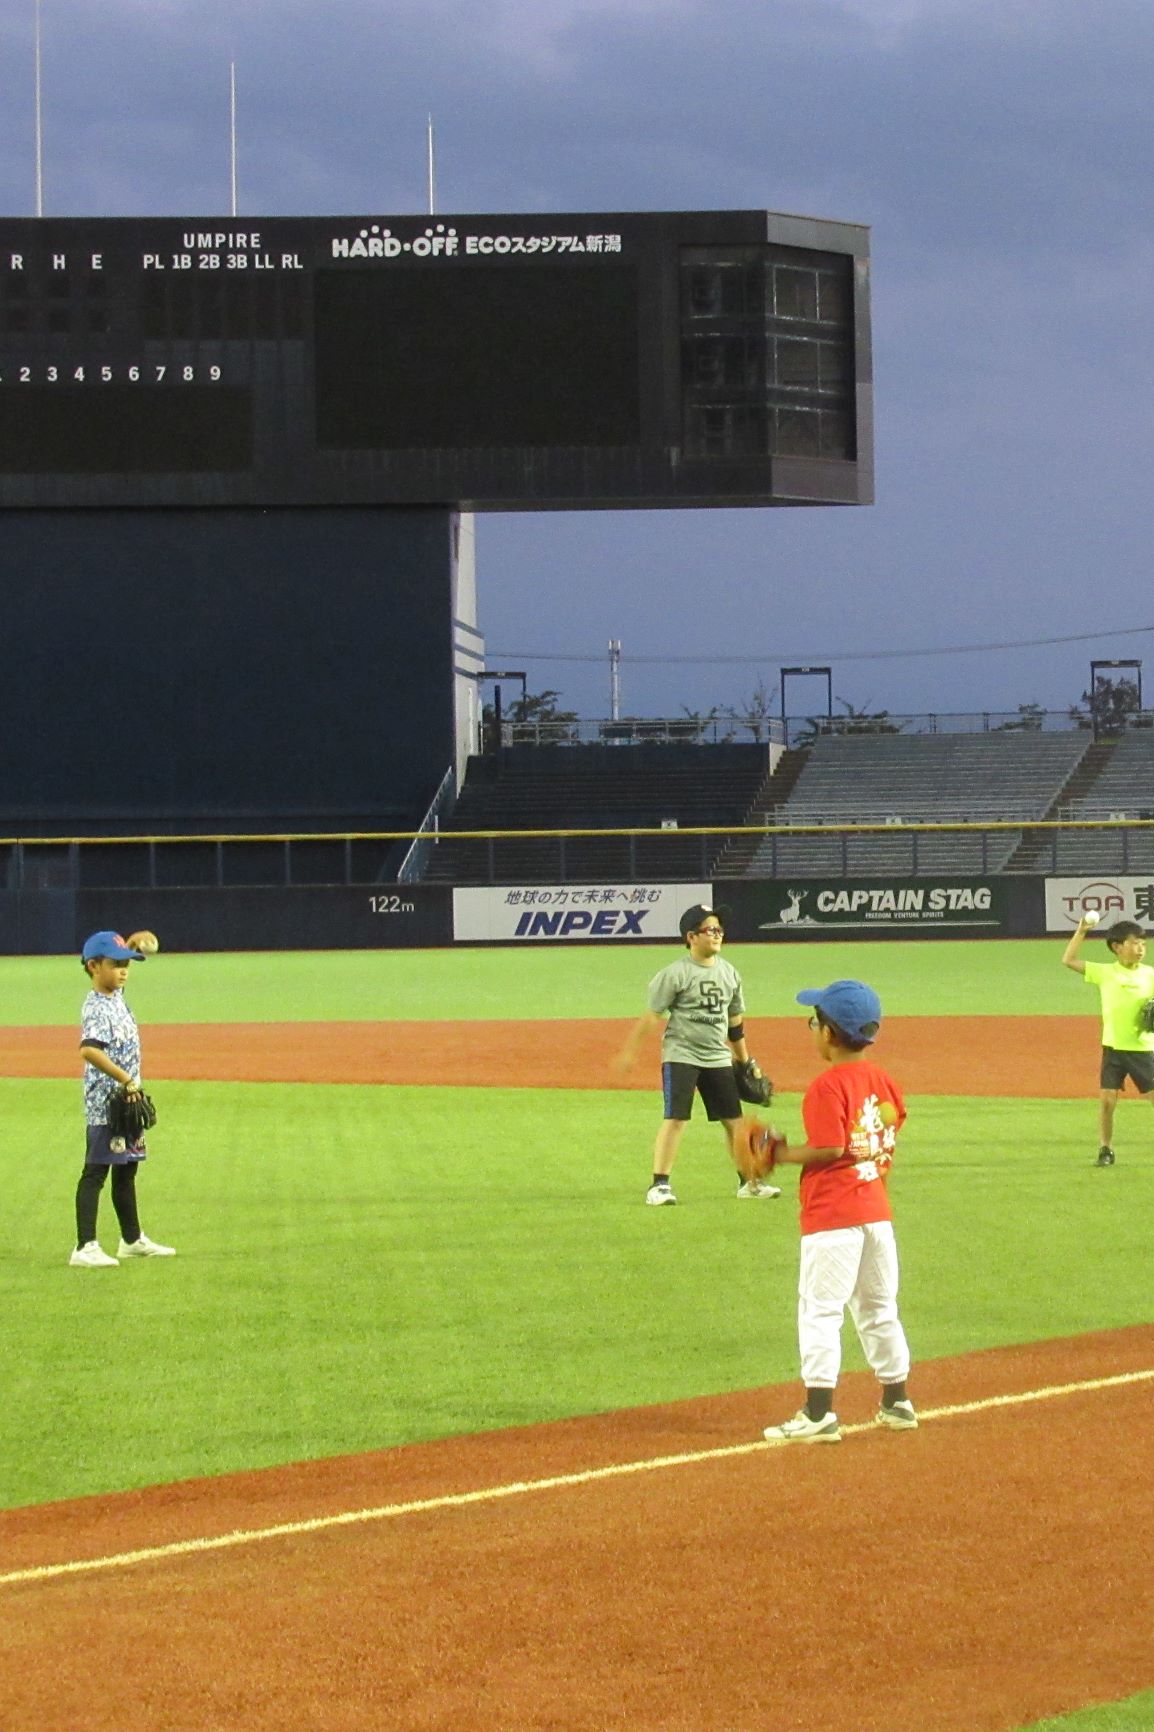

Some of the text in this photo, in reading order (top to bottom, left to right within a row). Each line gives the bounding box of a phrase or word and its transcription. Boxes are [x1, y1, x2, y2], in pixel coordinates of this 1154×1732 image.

[183, 233, 261, 249] UMPIRE
[11, 254, 23, 270] R
[53, 254, 66, 270] H
[92, 254, 102, 270] E
[143, 254, 304, 269] PL 1B 2B 3B LL RL
[20, 366, 221, 382] 2 3 4 5 6 7 8 9
[504, 888, 662, 906] 地球の力で未来へ挑む
[817, 888, 992, 913] CAPTAIN STAG
[1062, 895, 1125, 912] TOA
[514, 909, 650, 937] INPEX
